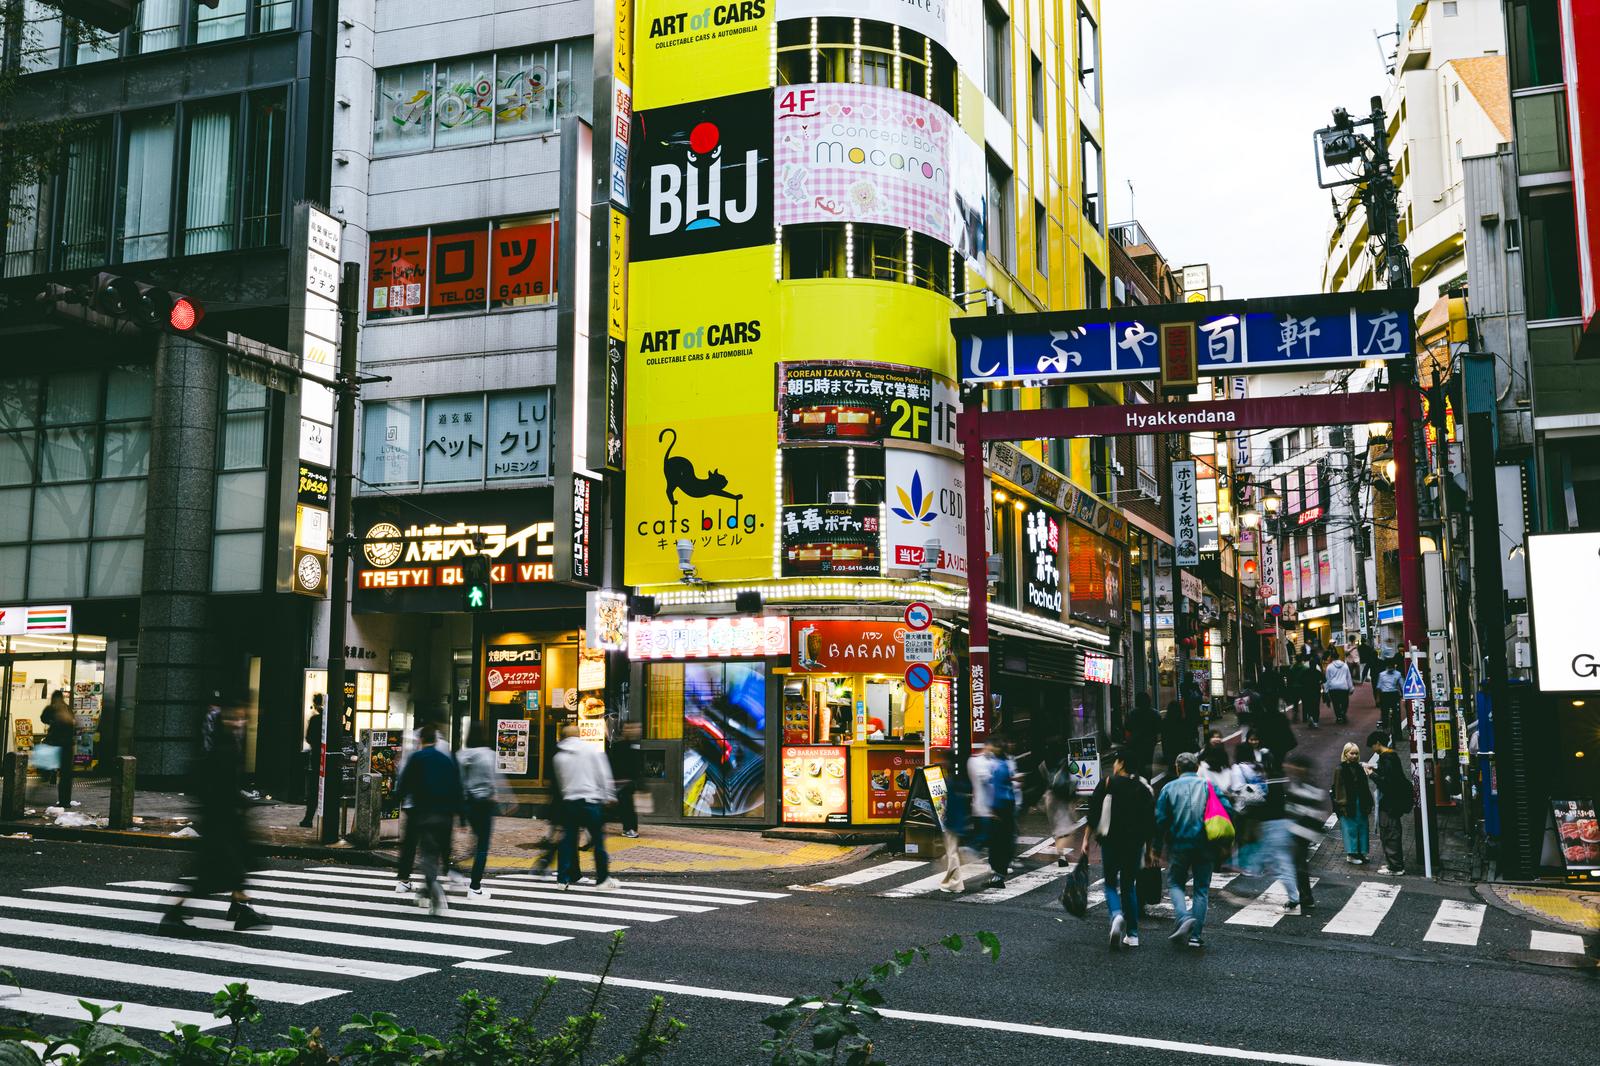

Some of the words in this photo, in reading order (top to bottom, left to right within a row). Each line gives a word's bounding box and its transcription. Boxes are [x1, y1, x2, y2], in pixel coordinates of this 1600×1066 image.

[649, 12, 689, 39] ART
[690, 8, 711, 31] of
[713, 0, 766, 26] CARS
[655, 36, 694, 50] COLLECTABLE
[694, 32, 711, 43] CARS
[711, 32, 717, 40] &
[717, 25, 759, 38] AUTOMOBILIA
[779, 89, 816, 113] 4F
[831, 123, 909, 146] Concept
[913, 136, 937, 154] Bar
[373, 246, 420, 265] フリー
[499, 281, 544, 298] 6416
[640, 329, 681, 354] ART
[683, 326, 705, 350] of
[707, 320, 761, 348] CARS
[969, 321, 1158, 378] しぶや
[1198, 307, 1402, 364] 百軒店
[646, 354, 687, 366] COLLECTABLE
[687, 353, 704, 362] CARS
[705, 352, 711, 361] &
[711, 348, 753, 360] AUTOMOBILIA
[787, 369, 822, 379] KOREAN
[824, 369, 862, 379] IZAKAYA
[865, 371, 884, 382] Chung
[787, 377, 931, 401] 朝5時まで元気で営業中
[438, 411, 473, 425] 道玄坂
[890, 398, 930, 440] 2F
[1126, 409, 1236, 429] Hyakkendana
[494, 459, 540, 475] トリミング
[940, 487, 964, 520] CBD
[1177, 467, 1195, 540] ホルモン焼肉
[573, 477, 585, 560] 焼肉ライク
[637, 506, 690, 536] cats
[701, 501, 765, 535] bldg.
[783, 508, 863, 536] 青春ポチャ
[361, 570, 429, 588] TASTY!
[442, 566, 505, 586] QUK!
[1028, 582, 1062, 613] Pocha.42
[861, 631, 884, 641] バラン
[488, 649, 535, 662] 焼肉ライク
[828, 643, 896, 659] BARAN
[503, 671, 541, 681] テイクアウト
[970, 664, 985, 733] 渋谷百軒店
